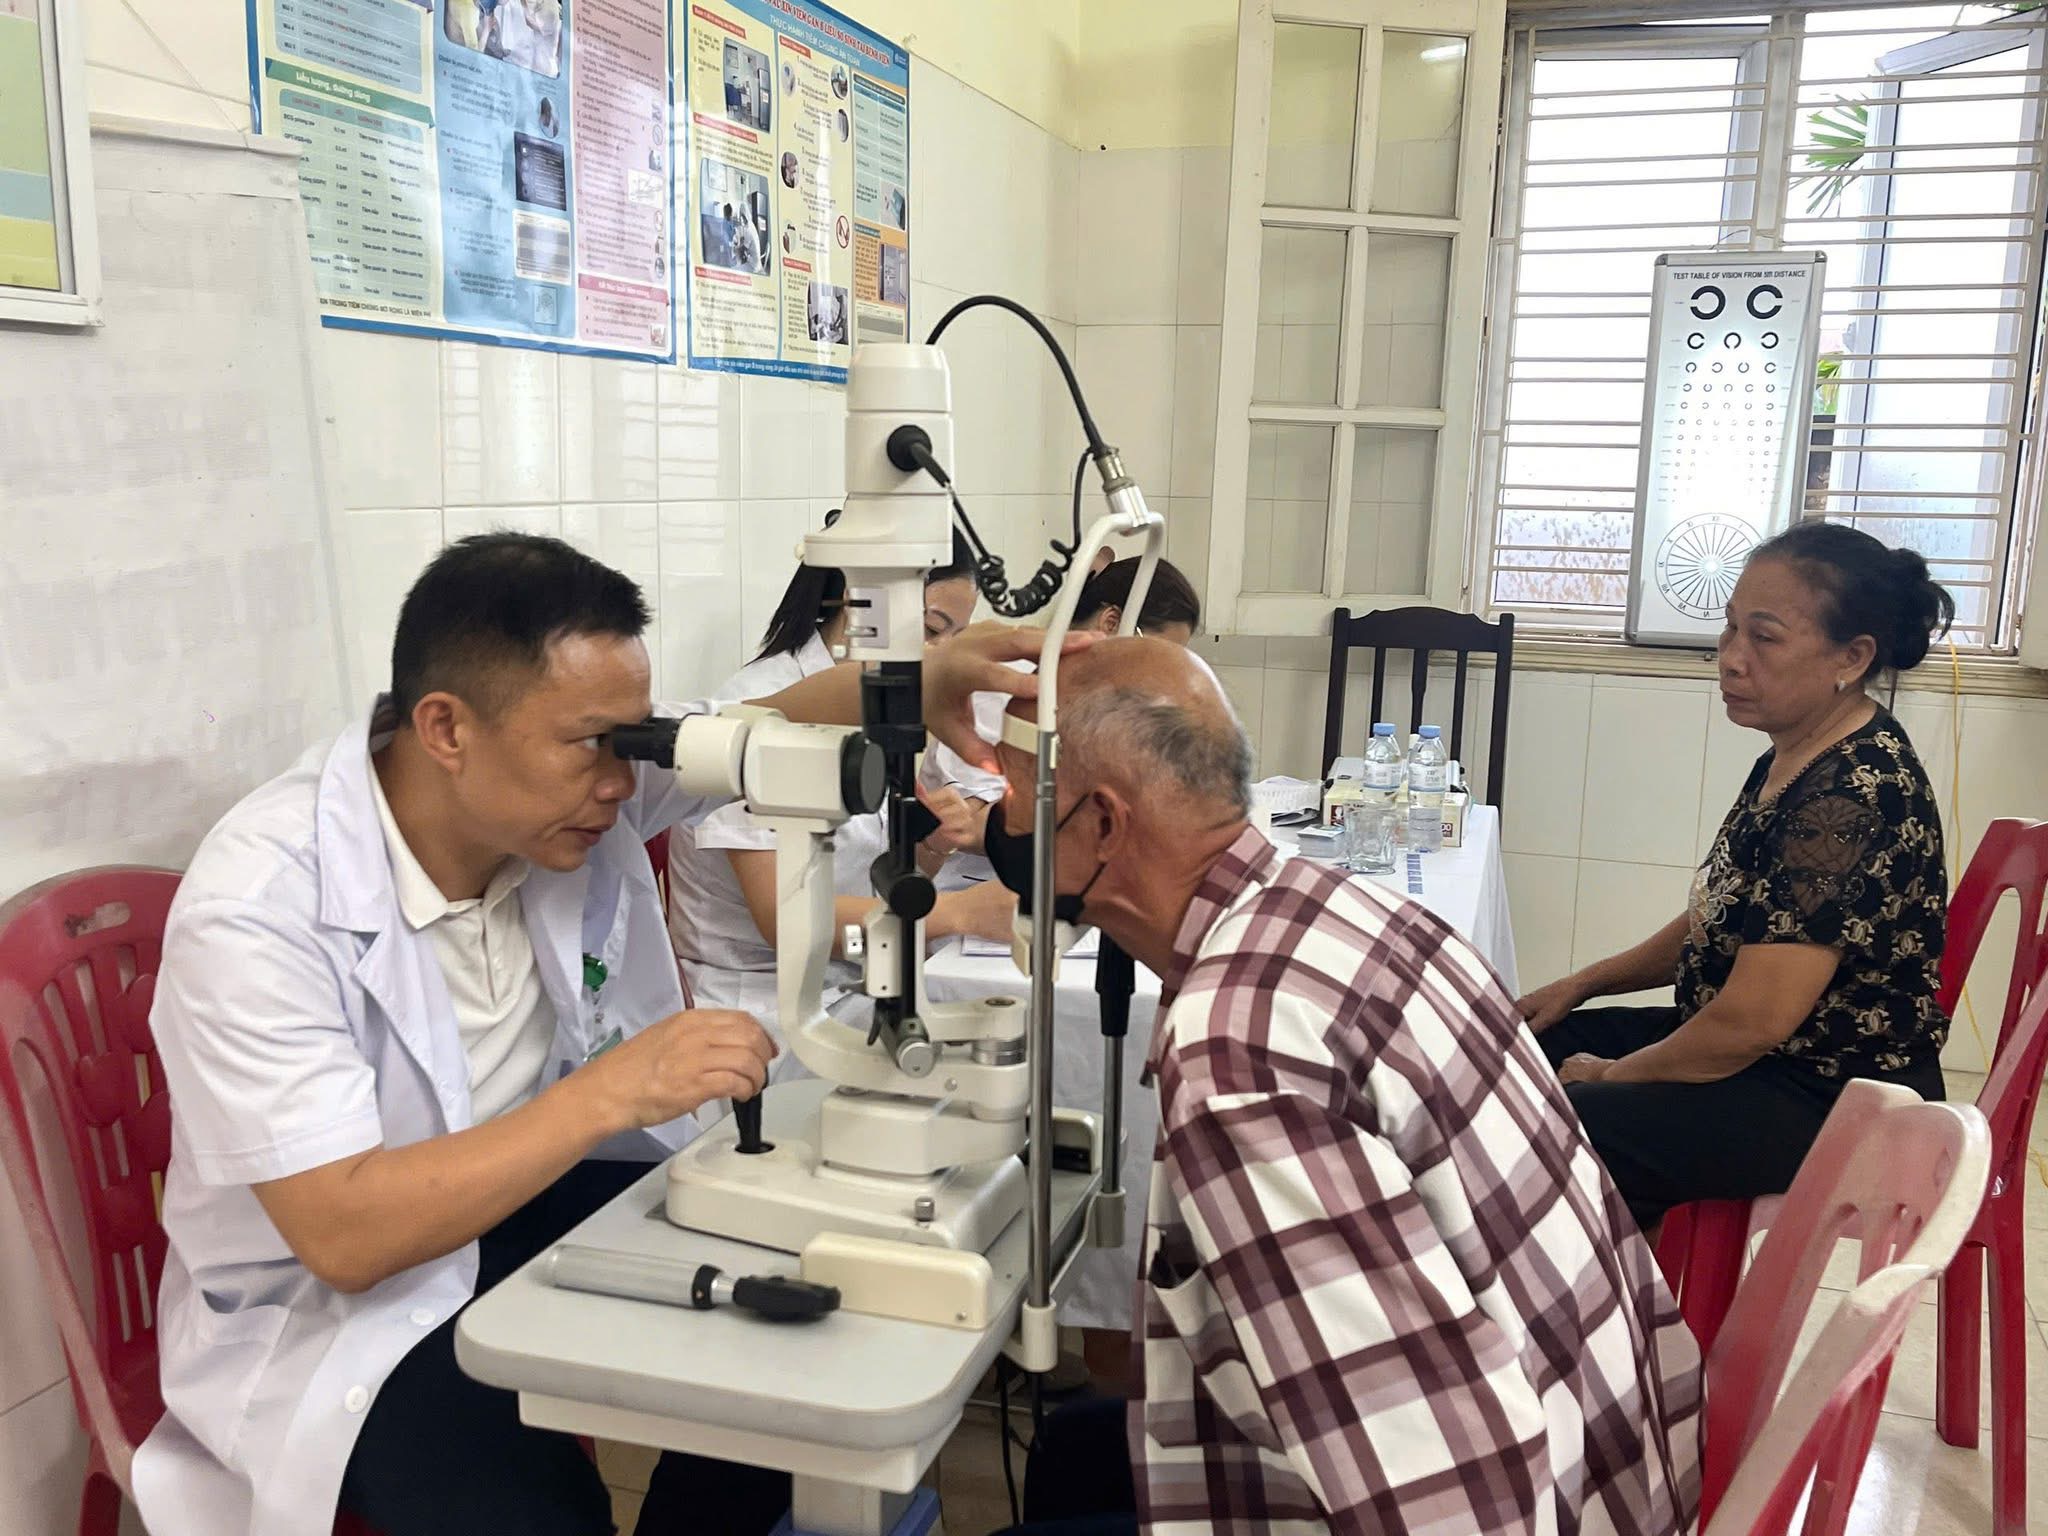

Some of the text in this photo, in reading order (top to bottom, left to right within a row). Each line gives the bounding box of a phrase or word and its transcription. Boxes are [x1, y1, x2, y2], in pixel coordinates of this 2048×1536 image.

[1674, 272, 1689, 280] TEST
[1690, 271, 1711, 280] TABLE
[1711, 271, 1721, 279] OF
[1721, 271, 1743, 279] VISION
[1743, 271, 1763, 279] FROM
[1773, 270, 1806, 278] DISTANCE
